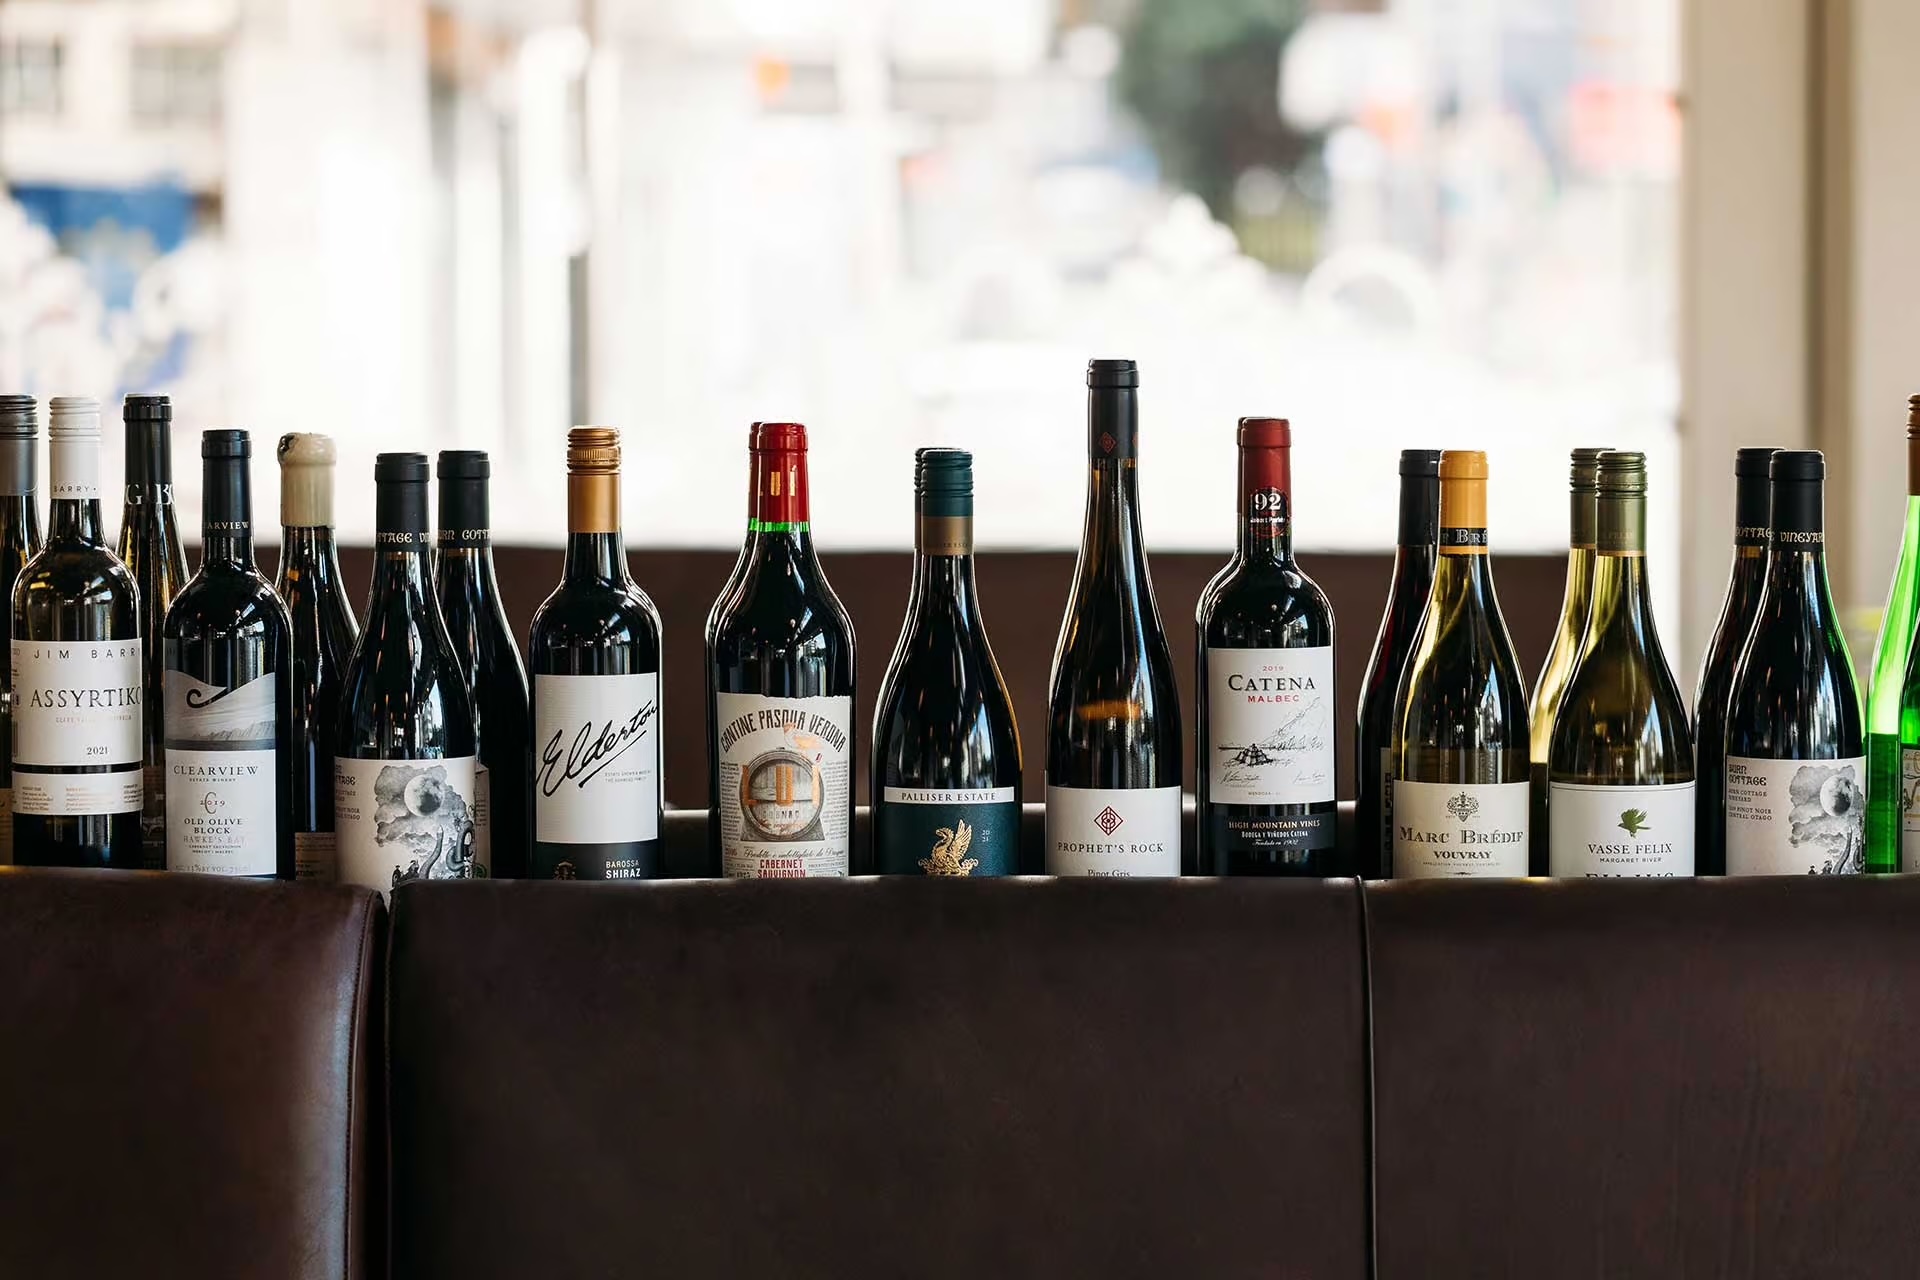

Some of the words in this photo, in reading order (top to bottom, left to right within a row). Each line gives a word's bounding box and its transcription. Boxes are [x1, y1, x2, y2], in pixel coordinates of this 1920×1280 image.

[1254, 493, 1281, 510] 92
[33, 649, 71, 660] JIM
[91, 647, 141, 660] BARR
[1227, 674, 1316, 692] CATENA
[30, 686, 142, 708] ASSYRTIKO
[1247, 694, 1300, 703] MALBEC
[720, 712, 758, 754] CANTINE
[808, 713, 847, 753] VERONA
[86, 746, 108, 755] 2021
[536, 700, 658, 798] Elderton
[173, 764, 259, 776] CLEARVIEW
[901, 792, 953, 802] PALLISER
[957, 792, 996, 801] ESTATE
[183, 817, 205, 826] OLD
[208, 818, 244, 827] OLIVE
[1228, 821, 1249, 829] HIGH
[1251, 821, 1298, 830] MOUNTAIN
[1299, 819, 1321, 828] VINES
[193, 827, 231, 835] BLOCK
[1400, 826, 1450, 844] MARC
[1460, 829, 1524, 844] BRÉDIF
[1058, 842, 1125, 854] PROPHET'S
[1131, 843, 1164, 853] ROCK
[1587, 844, 1631, 855] VASSE
[1635, 843, 1673, 855] FELIX
[1433, 850, 1493, 860] VOUVRAY
[605, 859, 640, 869] BAROSSA
[760, 859, 804, 869] CABERNET
[605, 868, 641, 880] SHIRAZ
[757, 869, 806, 879] SAUVIGNON
